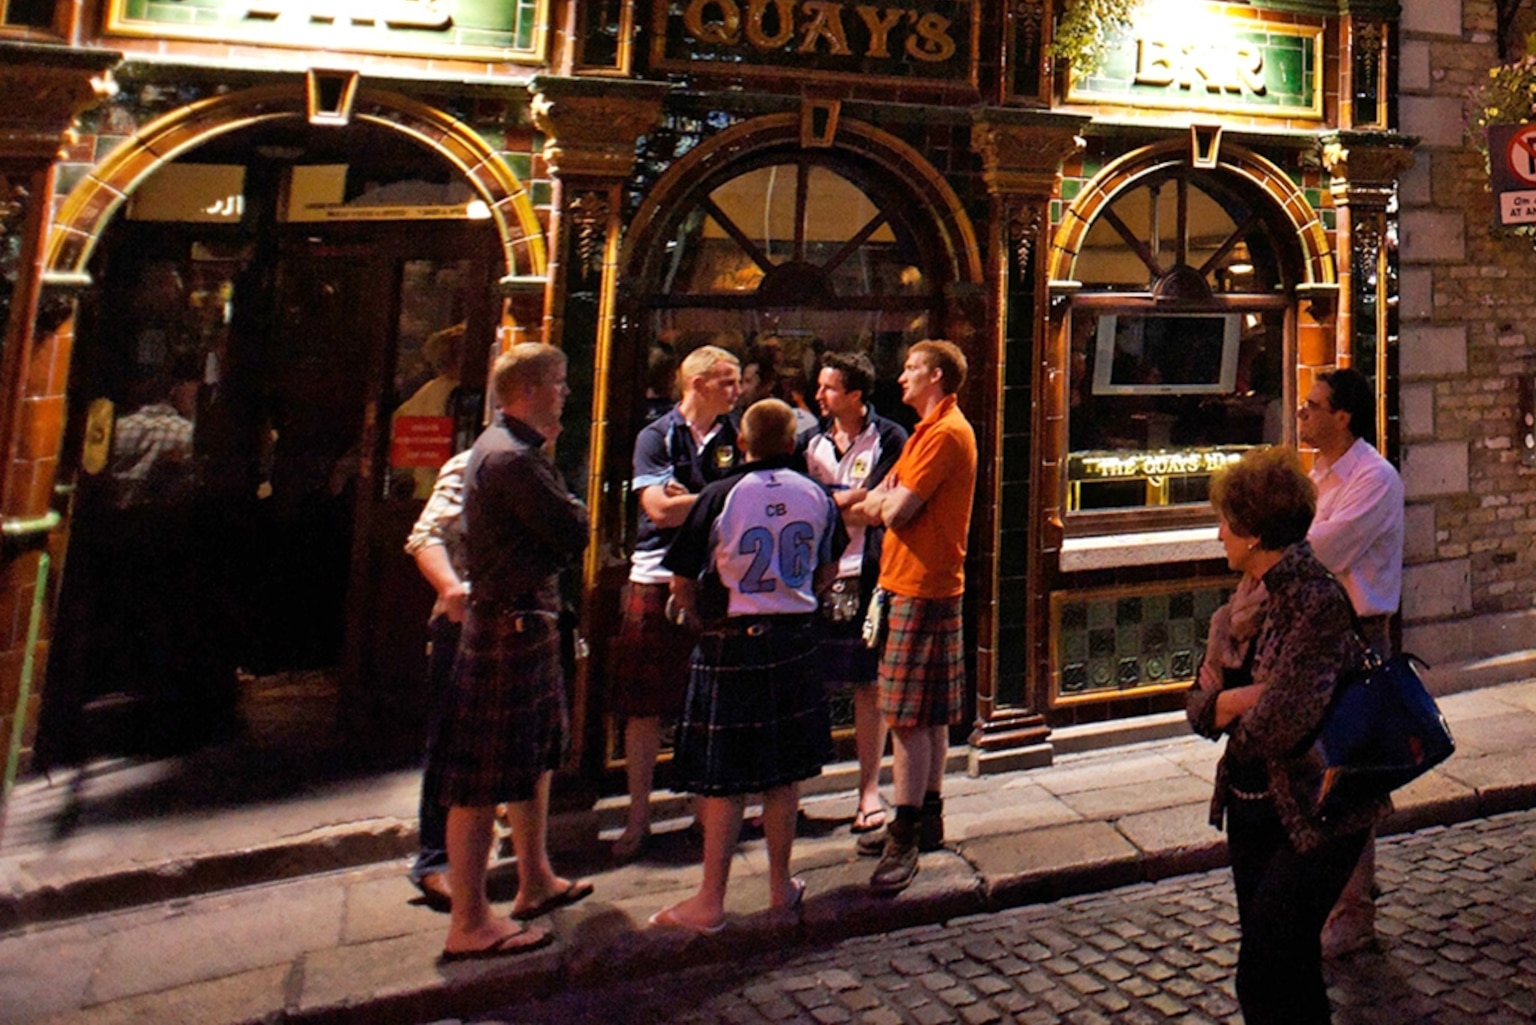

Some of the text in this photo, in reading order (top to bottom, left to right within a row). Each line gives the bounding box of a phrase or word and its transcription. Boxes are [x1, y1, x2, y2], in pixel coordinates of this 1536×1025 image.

[1133, 30, 1268, 97] BAR
[1510, 208, 1522, 217] AT
[766, 503, 787, 518] CB
[739, 521, 814, 594] 26
